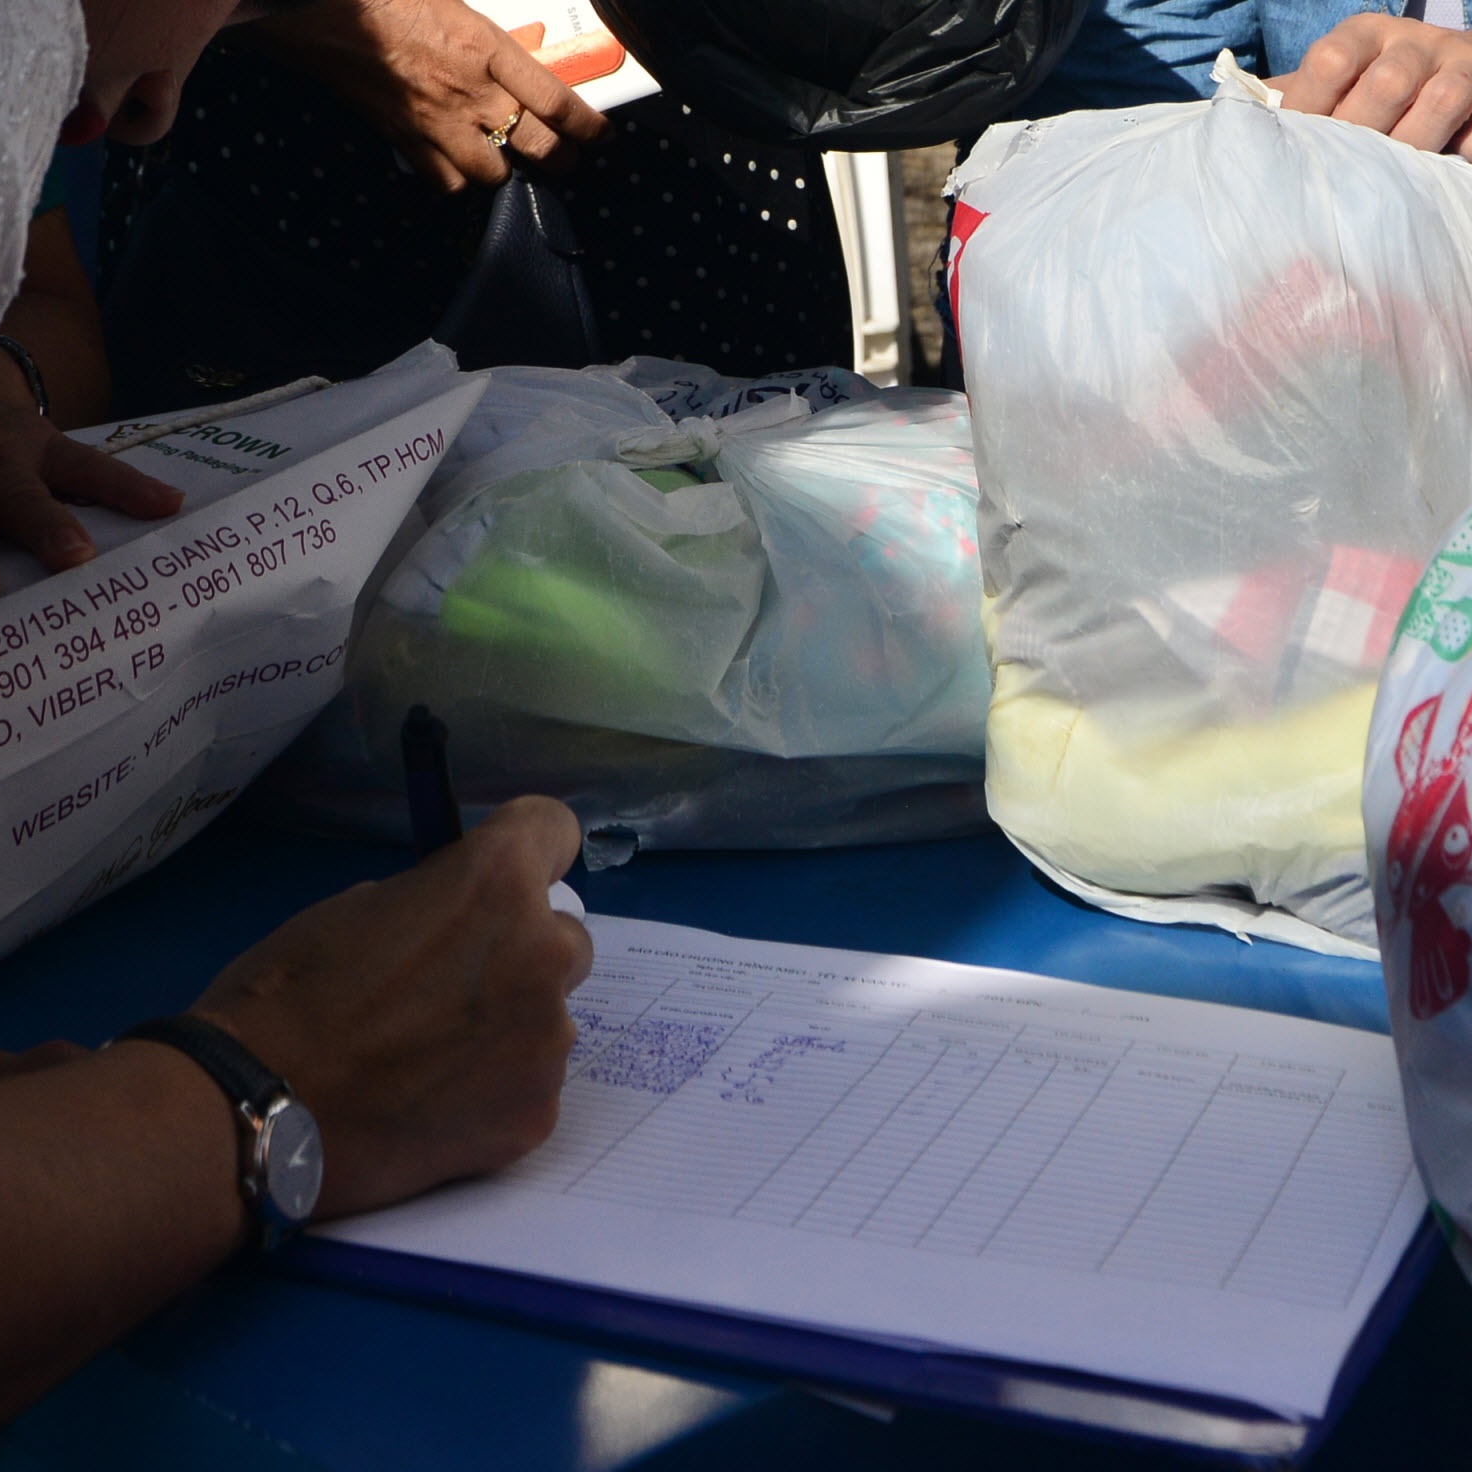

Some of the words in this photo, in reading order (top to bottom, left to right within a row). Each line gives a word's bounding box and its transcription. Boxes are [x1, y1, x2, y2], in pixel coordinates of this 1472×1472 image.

[83, 566, 149, 611] HAU
[151, 526, 251, 578] GIANG,
[246, 496, 314, 535] P.12,
[311, 473, 364, 505] Q.6,
[358, 428, 445, 484] TP.HCM
[54, 626, 106, 670] 394
[113, 601, 161, 641] 489
[181, 562, 242, 608] 0961
[246, 539, 287, 578] 807
[292, 519, 337, 556] 736
[27, 668, 124, 728] VIBER,
[130, 643, 166, 679] FB
[11, 755, 137, 847] WEBSITE:
